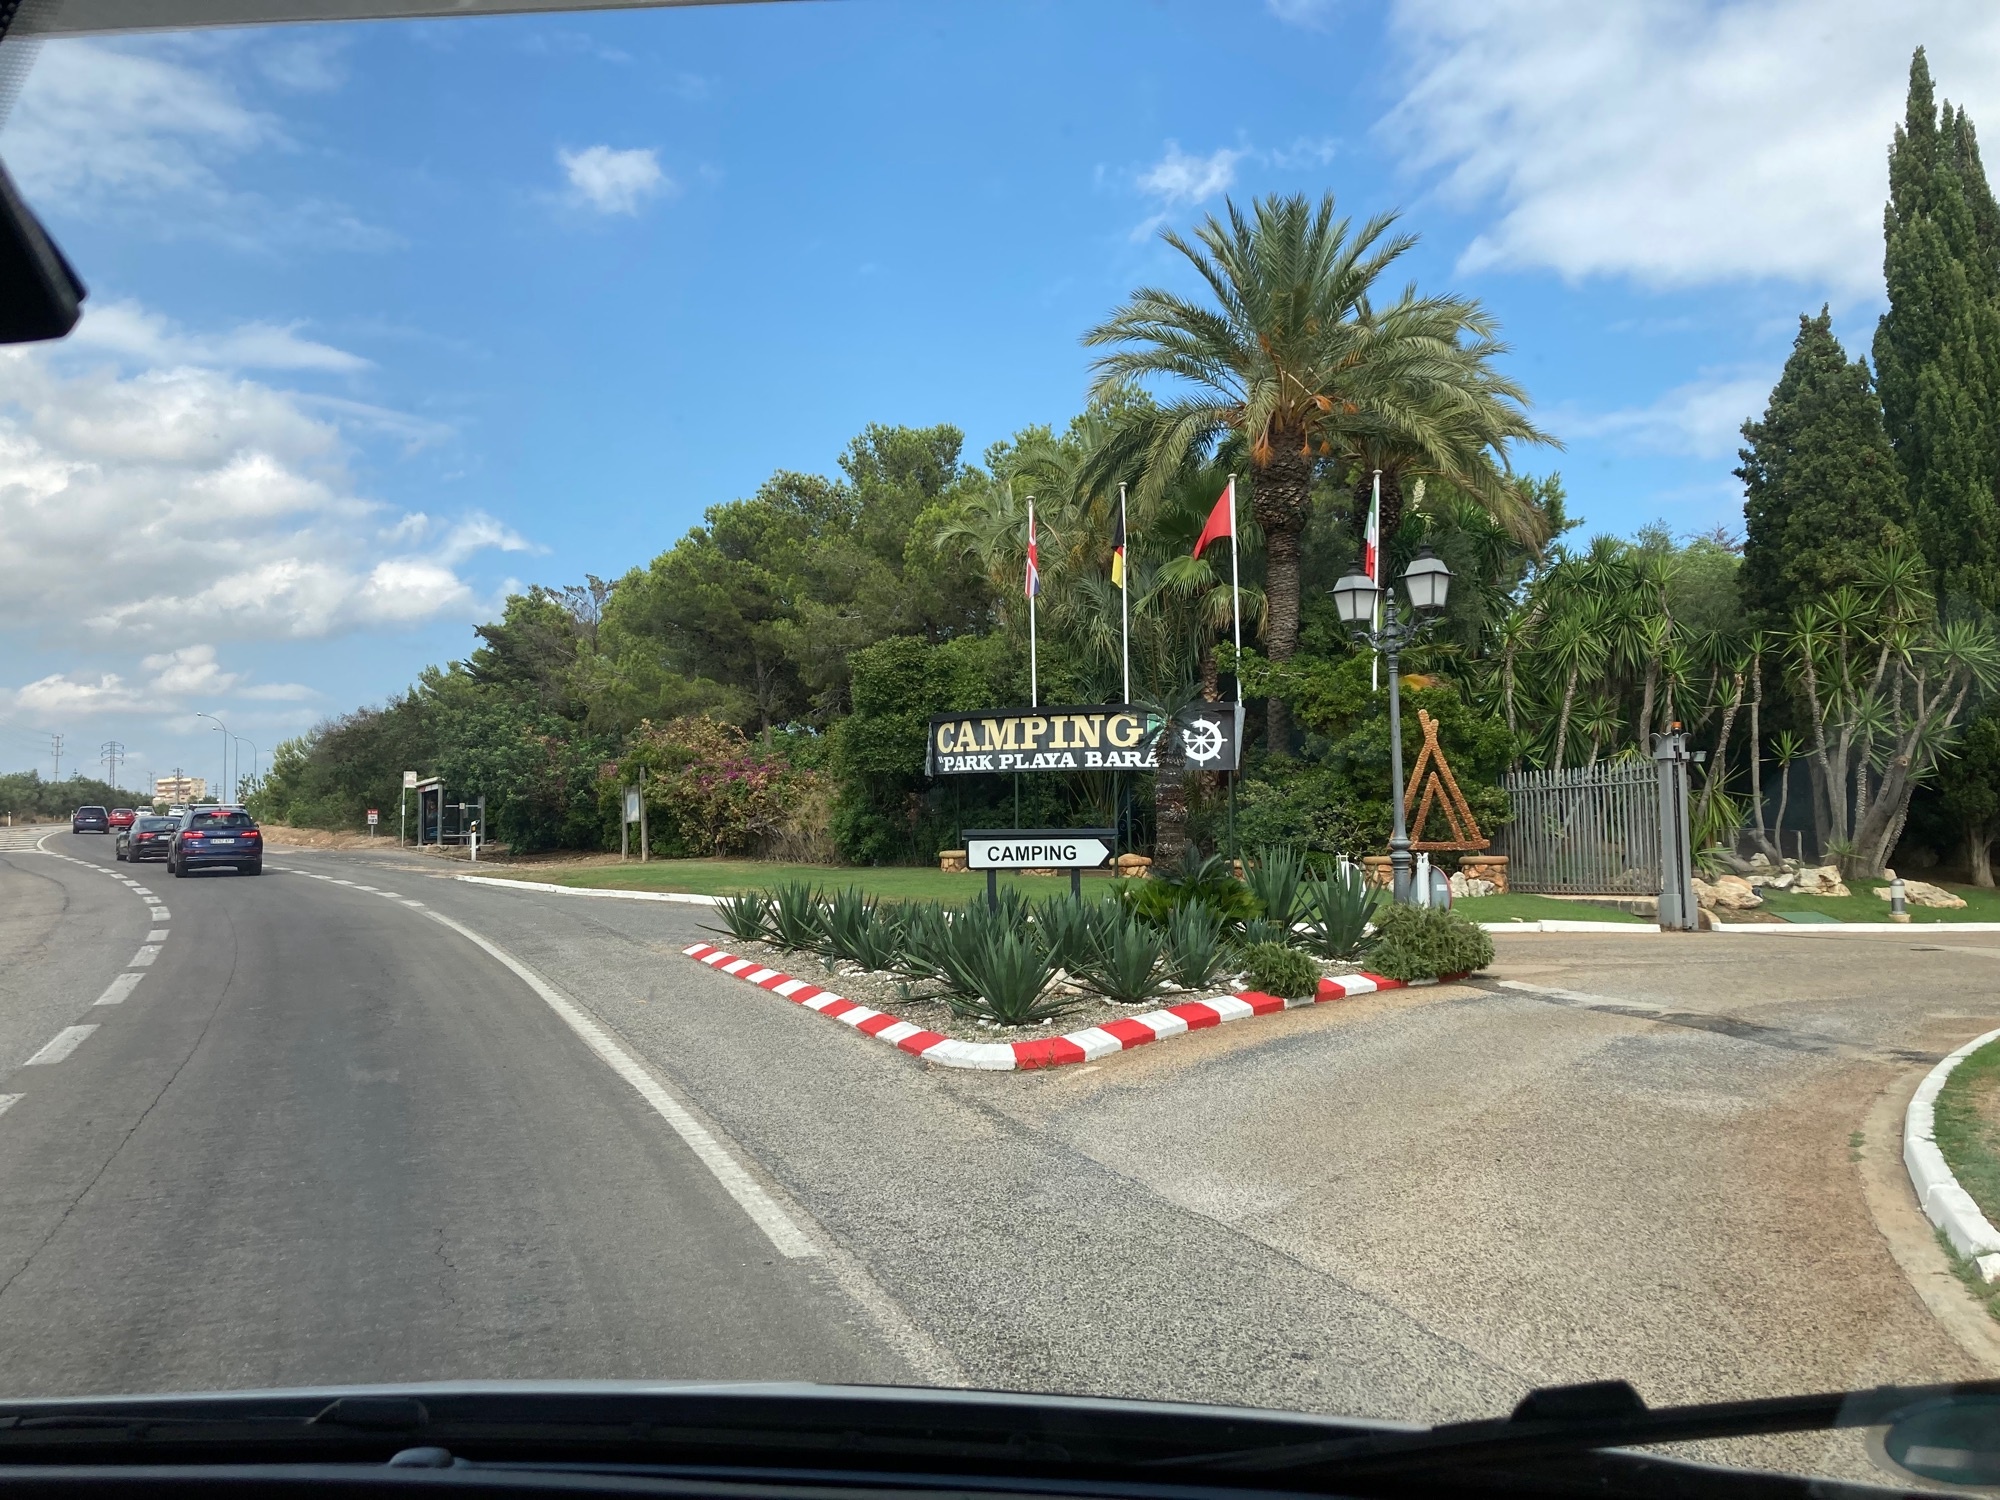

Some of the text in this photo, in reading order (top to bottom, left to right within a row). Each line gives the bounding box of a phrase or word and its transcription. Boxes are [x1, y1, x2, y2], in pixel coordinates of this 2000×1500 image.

[937, 714, 1143, 754] CAMPING
[998, 752, 1077, 769] PLAYA
[987, 845, 1077, 861] CAMPING
